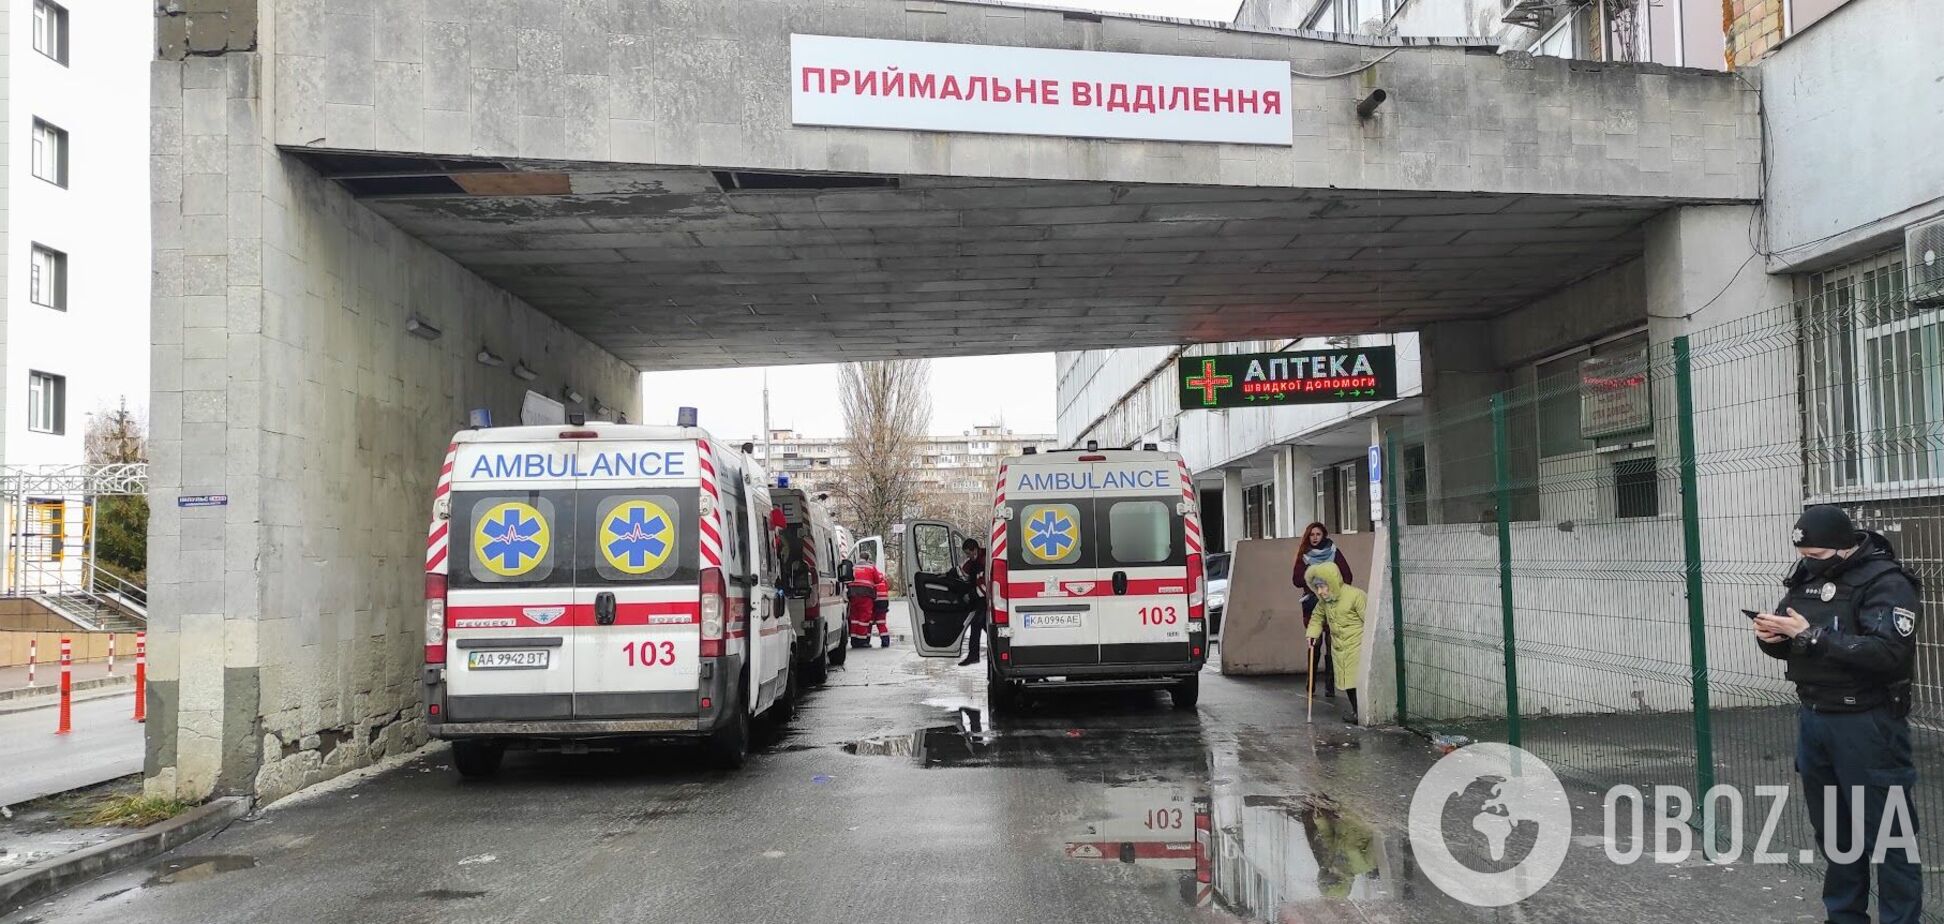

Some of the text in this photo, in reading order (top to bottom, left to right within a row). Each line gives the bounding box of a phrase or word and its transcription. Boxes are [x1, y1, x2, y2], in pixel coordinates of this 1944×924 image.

[801, 65, 1282, 115] ПРИЙМАЛЬНЕ ВІДДІЛЕННЯ
[1244, 353, 1375, 382] АПТЕКА
[1244, 377, 1376, 394] ШВИДКОЇ ДОПОМОГИ
[470, 451, 685, 479] AMBULANCE
[1017, 469, 1170, 491] AMBULANCE
[1138, 606, 1177, 625] 103
[478, 652, 545, 665] AA 9942 BT
[622, 640, 676, 667] 103
